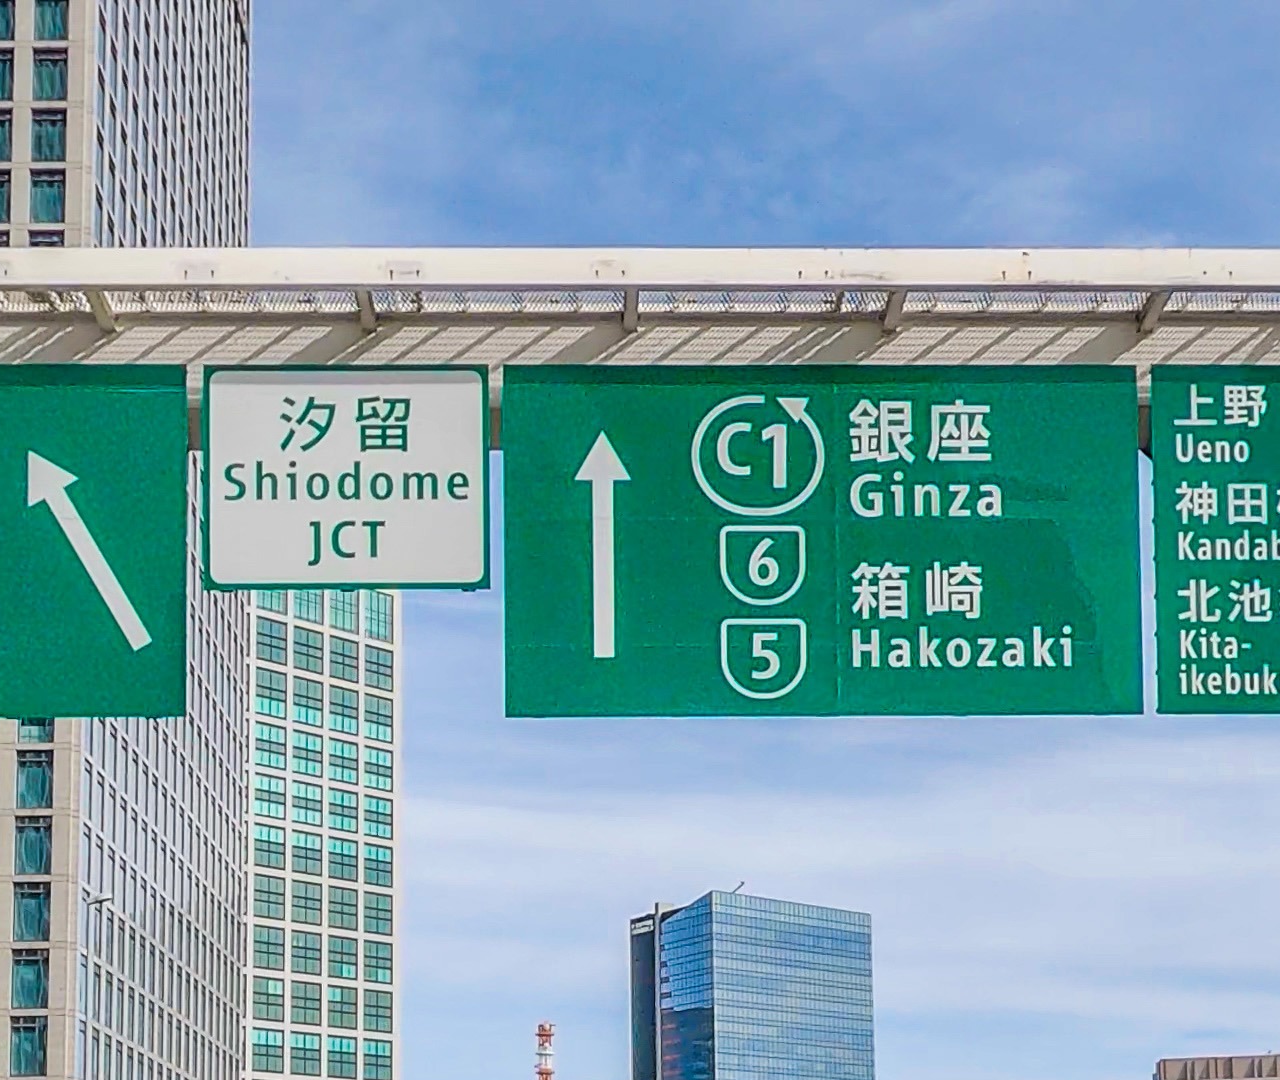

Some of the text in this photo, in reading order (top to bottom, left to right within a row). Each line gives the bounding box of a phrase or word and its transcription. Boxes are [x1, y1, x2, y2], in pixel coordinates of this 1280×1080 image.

[279, 396, 412, 453] 汐留
[1174, 384, 1267, 427] 上野
[849, 398, 993, 464] 銀座
[1175, 434, 1250, 464] Ueno
[717, 421, 788, 489] C1
[223, 462, 470, 501] Shiodome
[850, 472, 1003, 518] Ginza
[307, 520, 386, 565] JCT
[747, 538, 778, 587] 6
[851, 561, 983, 620] 箱崎
[751, 632, 780, 681] 5
[851, 627, 1073, 668] Hakozaki
[1180, 630, 1252, 660] Kita-
